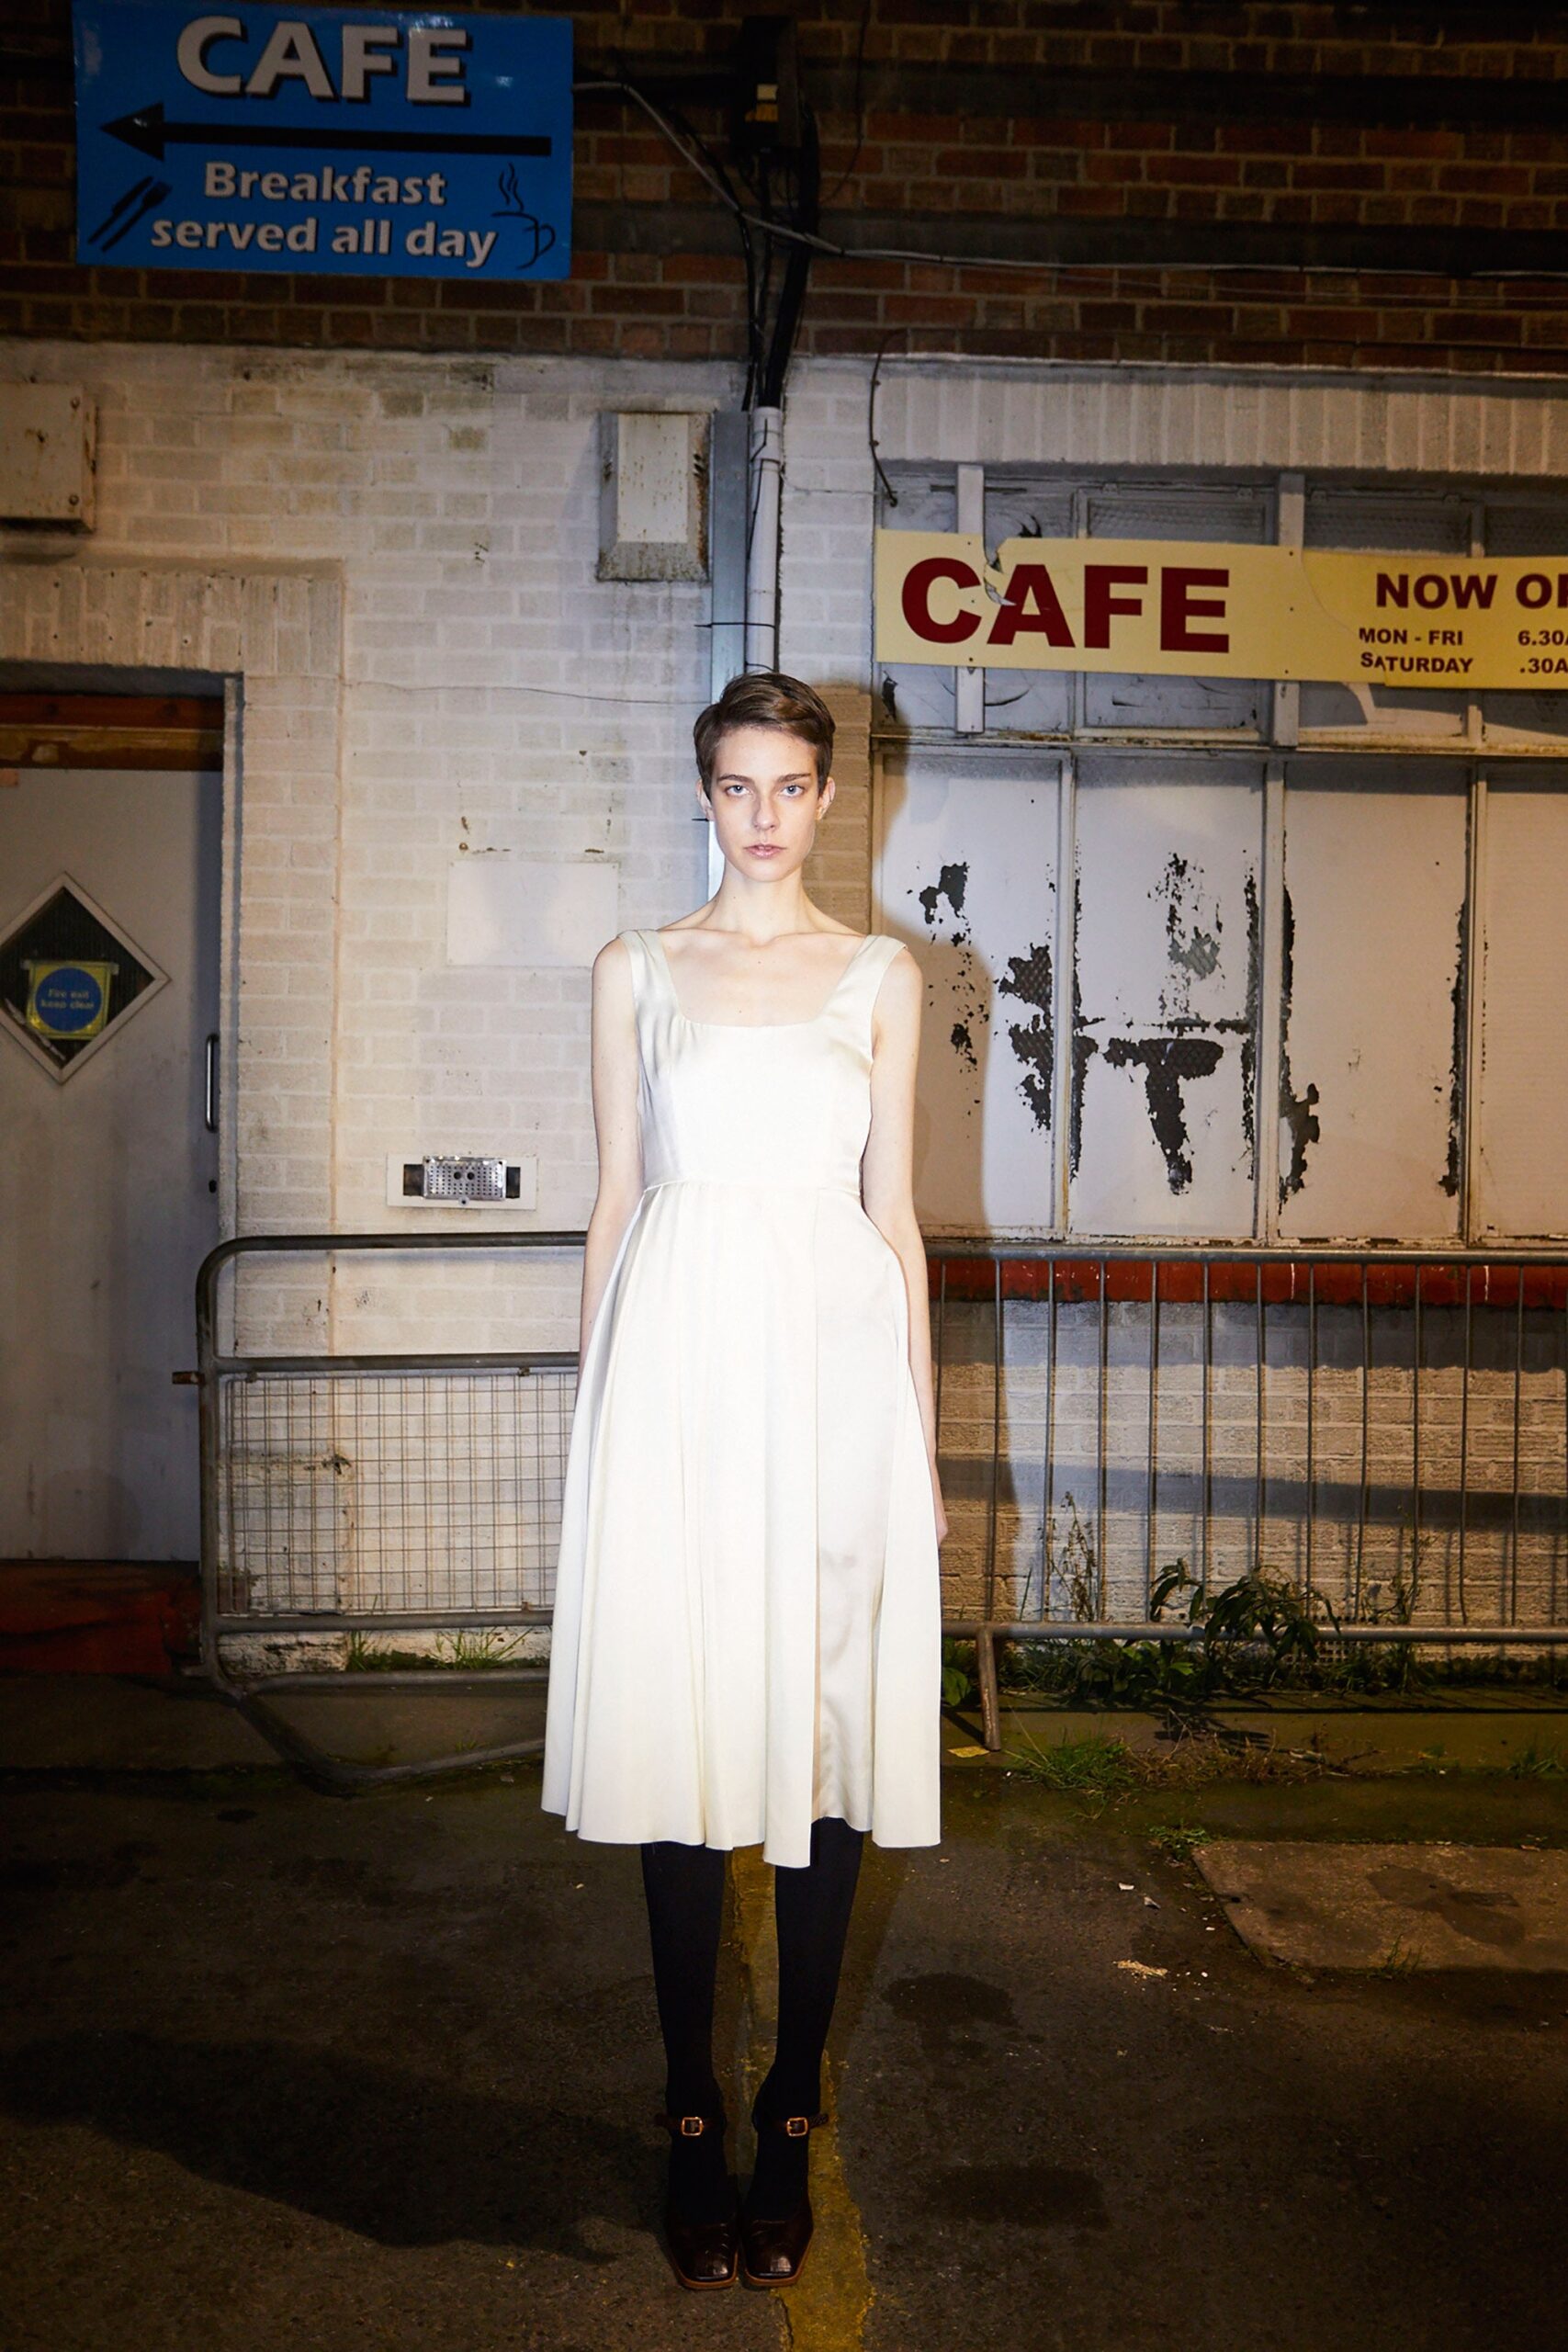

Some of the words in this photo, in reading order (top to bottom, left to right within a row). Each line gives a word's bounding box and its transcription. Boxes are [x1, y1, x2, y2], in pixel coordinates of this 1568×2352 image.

[176, 16, 470, 105] CAFE
[203, 161, 447, 206] Breakfast
[151, 218, 318, 253] served
[332, 220, 390, 255] all
[405, 220, 498, 267] day
[901, 557, 1230, 653] CAFE
[1376, 572, 1498, 609] NOW
[1359, 628, 1408, 644] MON
[1428, 629, 1463, 646] FRI
[1518, 629, 1568, 646] 6.30
[1360, 651, 1473, 673] SATURDAY
